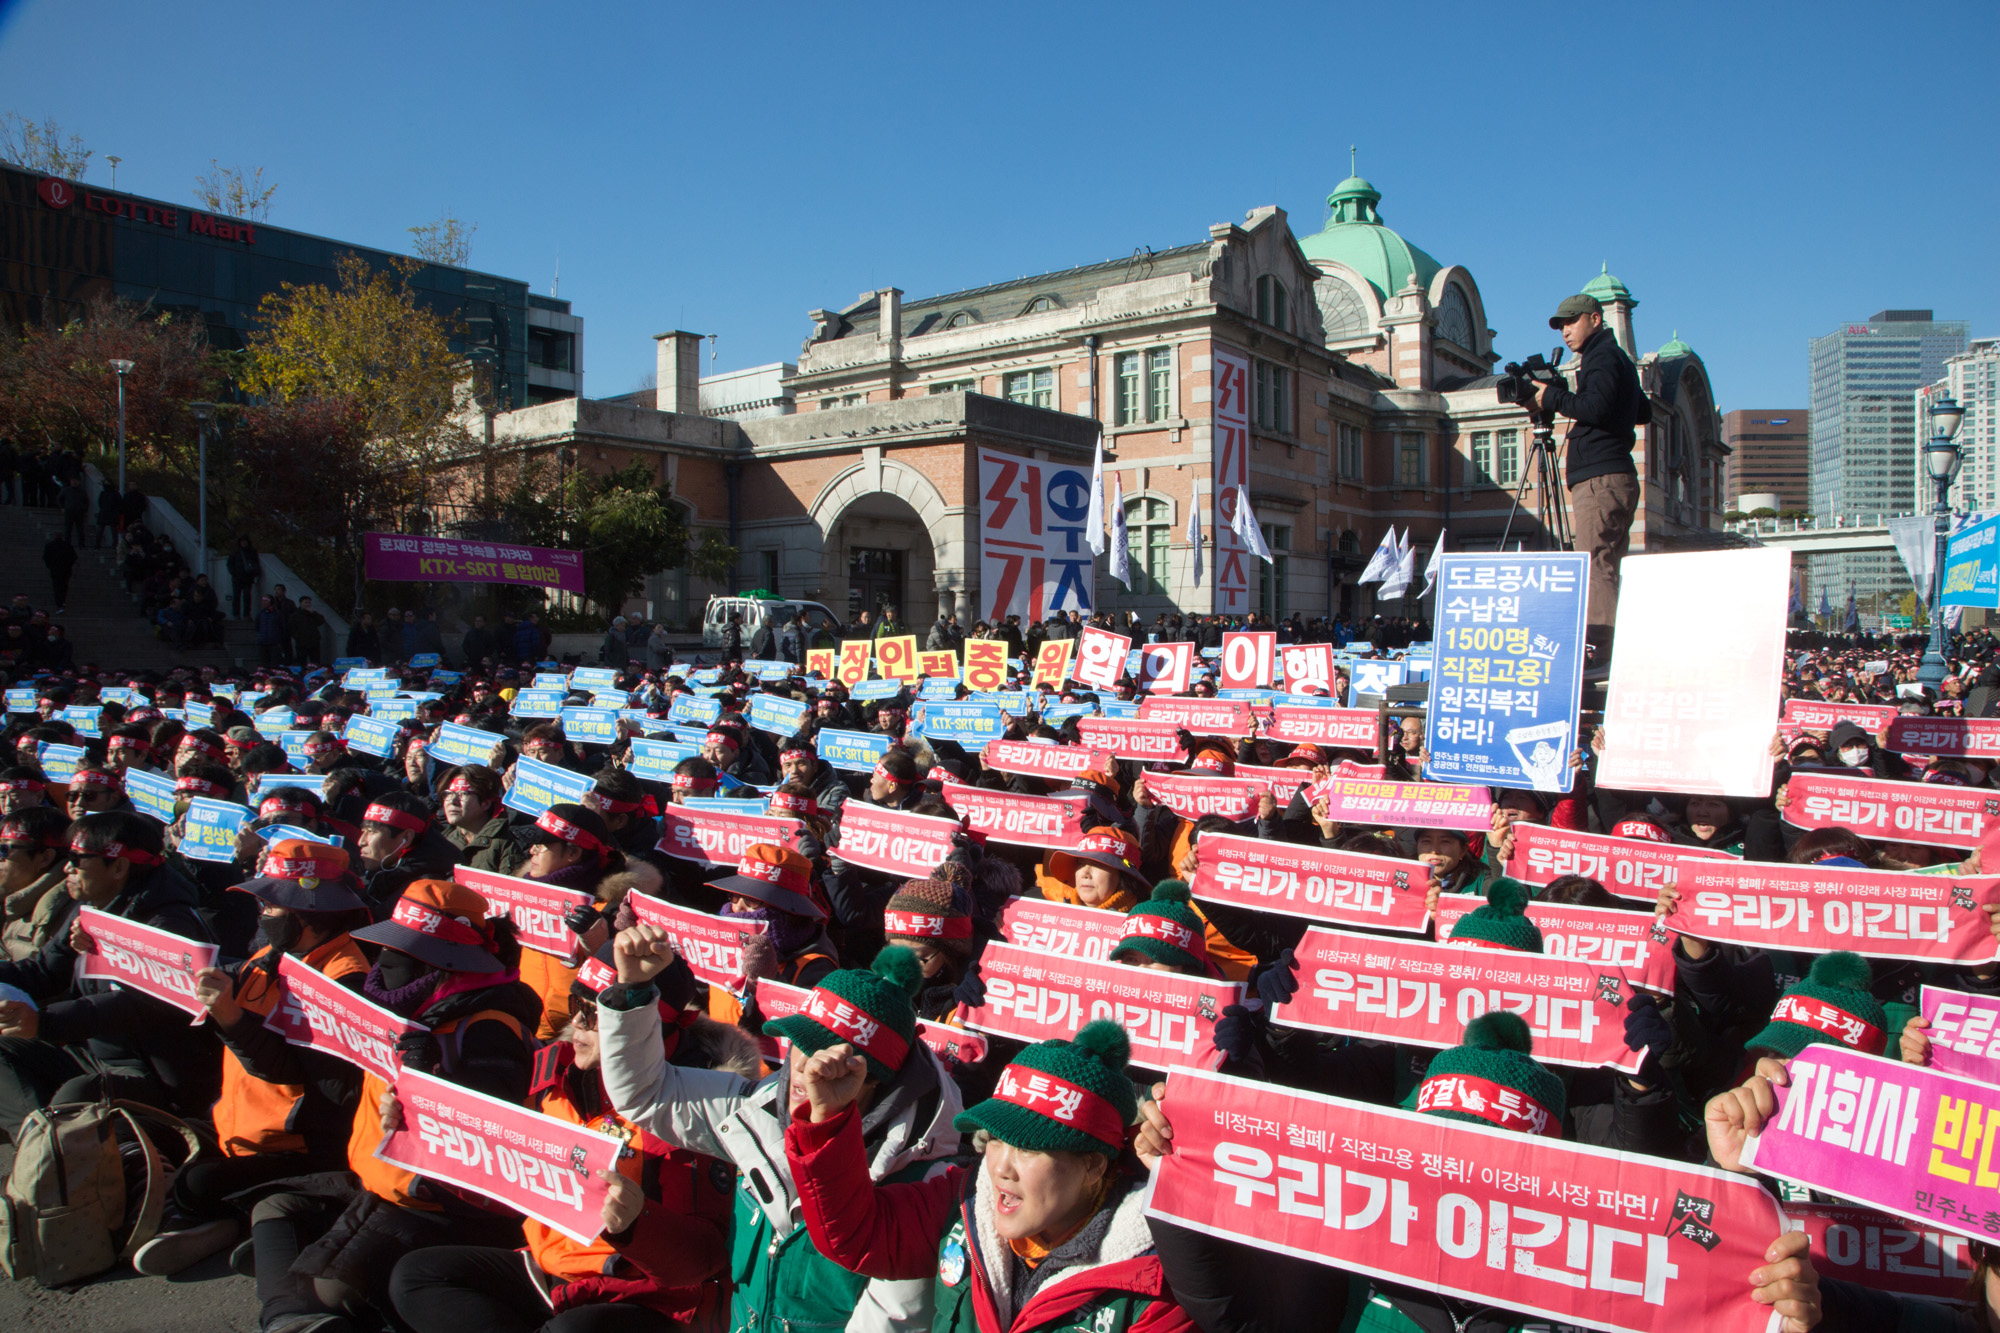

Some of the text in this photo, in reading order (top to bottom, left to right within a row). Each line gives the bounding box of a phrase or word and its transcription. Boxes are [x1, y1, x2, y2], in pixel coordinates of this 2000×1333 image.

[85, 192, 257, 245] LOTTE Mart
[1847, 325, 1868, 335] AIA
[379, 538, 419, 554] 문재인
[422, 540, 459, 557] 정부는
[420, 558, 560, 585] KTX-SRT 통합하라
[1448, 564, 1576, 594] 도로공사는
[1446, 595, 1520, 622] 수납원
[1446, 627, 1530, 655] 1500명
[879, 639, 914, 680] 인
[968, 643, 1004, 688] 충
[1036, 642, 1070, 686] 원
[1079, 632, 1126, 688] 합
[1142, 645, 1188, 692] 의
[1225, 635, 1270, 686] 이
[1285, 647, 1329, 697] 행
[1442, 656, 1551, 686] 직접고용!
[675, 706, 702, 718] KTX-SRT
[1439, 686, 1539, 718] 원직복직
[566, 721, 596, 734] KTX-SRT
[932, 717, 974, 730] KTX-SRT
[1192, 711, 1235, 728] 이긴다
[1280, 720, 1375, 740] 우리가 이긴다
[1437, 718, 1494, 745] 하라!
[1792, 711, 1833, 725] 우리가
[825, 745, 862, 761] KTX-SRT
[1081, 731, 1178, 754] 우리가 이긴다
[1901, 730, 1958, 748] 우리가
[997, 745, 1091, 771] 우리가 이긴다
[785, 794, 808, 812] 투쟁
[1197, 796, 1248, 815] 이긴다
[1334, 782, 1471, 802] 1500명 집단해고
[1341, 796, 1490, 818] 청와대가 책임져라!
[370, 804, 392, 821] 투쟁
[1005, 810, 1065, 837] 이긴다
[1804, 796, 1985, 838] 우리가 이긴다
[553, 818, 579, 840] 투쟁
[674, 825, 726, 855] 우리가
[1622, 822, 1648, 836] 단결
[838, 826, 949, 867] 우리가 이긴다
[1097, 836, 1126, 855] 투쟁
[283, 860, 315, 877] 투쟁
[751, 860, 782, 882] 투쟁
[1528, 848, 1610, 882] 우리가
[1215, 862, 1395, 916] 우리가 이긴다
[1695, 875, 1943, 900] 비정규직 철폐! 직접고용 쟁취! 이강래 사장 파면!
[403, 907, 442, 933] 투쟁
[516, 905, 568, 942] 이긴다
[909, 915, 944, 936] 투쟁
[1695, 891, 1954, 944] 우리가 이긴다
[1011, 922, 1080, 956] 우리가
[1157, 921, 1192, 950] 투쟁
[682, 937, 744, 978] 이긴다
[1544, 934, 1651, 969] 이긴다
[98, 938, 198, 1000] 우리가 이긴다
[1316, 948, 1589, 993] 비정규직 철폐! 직접고용 쟁취! 이강래 사장 파면!
[987, 960, 1193, 1010] 비정규직 철폐! 직접고용 쟁취! 이강래 사장 파면!
[984, 976, 1083, 1031] 우리가
[1313, 968, 1599, 1044] 우리가 이긴다
[282, 990, 399, 1082] 우리가 이긴다
[828, 1002, 879, 1047] 투쟁
[1814, 1009, 1866, 1045] 투쟁
[1020, 1074, 1084, 1122] 투쟁
[1416, 1077, 1549, 1135] 단결 투쟁
[411, 1093, 568, 1162] 비정규직 철폐! 직접고용 쟁취! 이강래 사장 파면!
[1777, 1060, 1920, 1167] 자회사
[418, 1113, 584, 1212] 우리가 이긴다
[1214, 1111, 1660, 1223] 비정규직 철폐! 직접고용 쟁취! 이강래 사장 파면!
[1676, 1196, 1712, 1220] 단결
[1213, 1141, 1679, 1308] 우리가 이긴다
[1681, 1224, 1714, 1244] 투쟁
